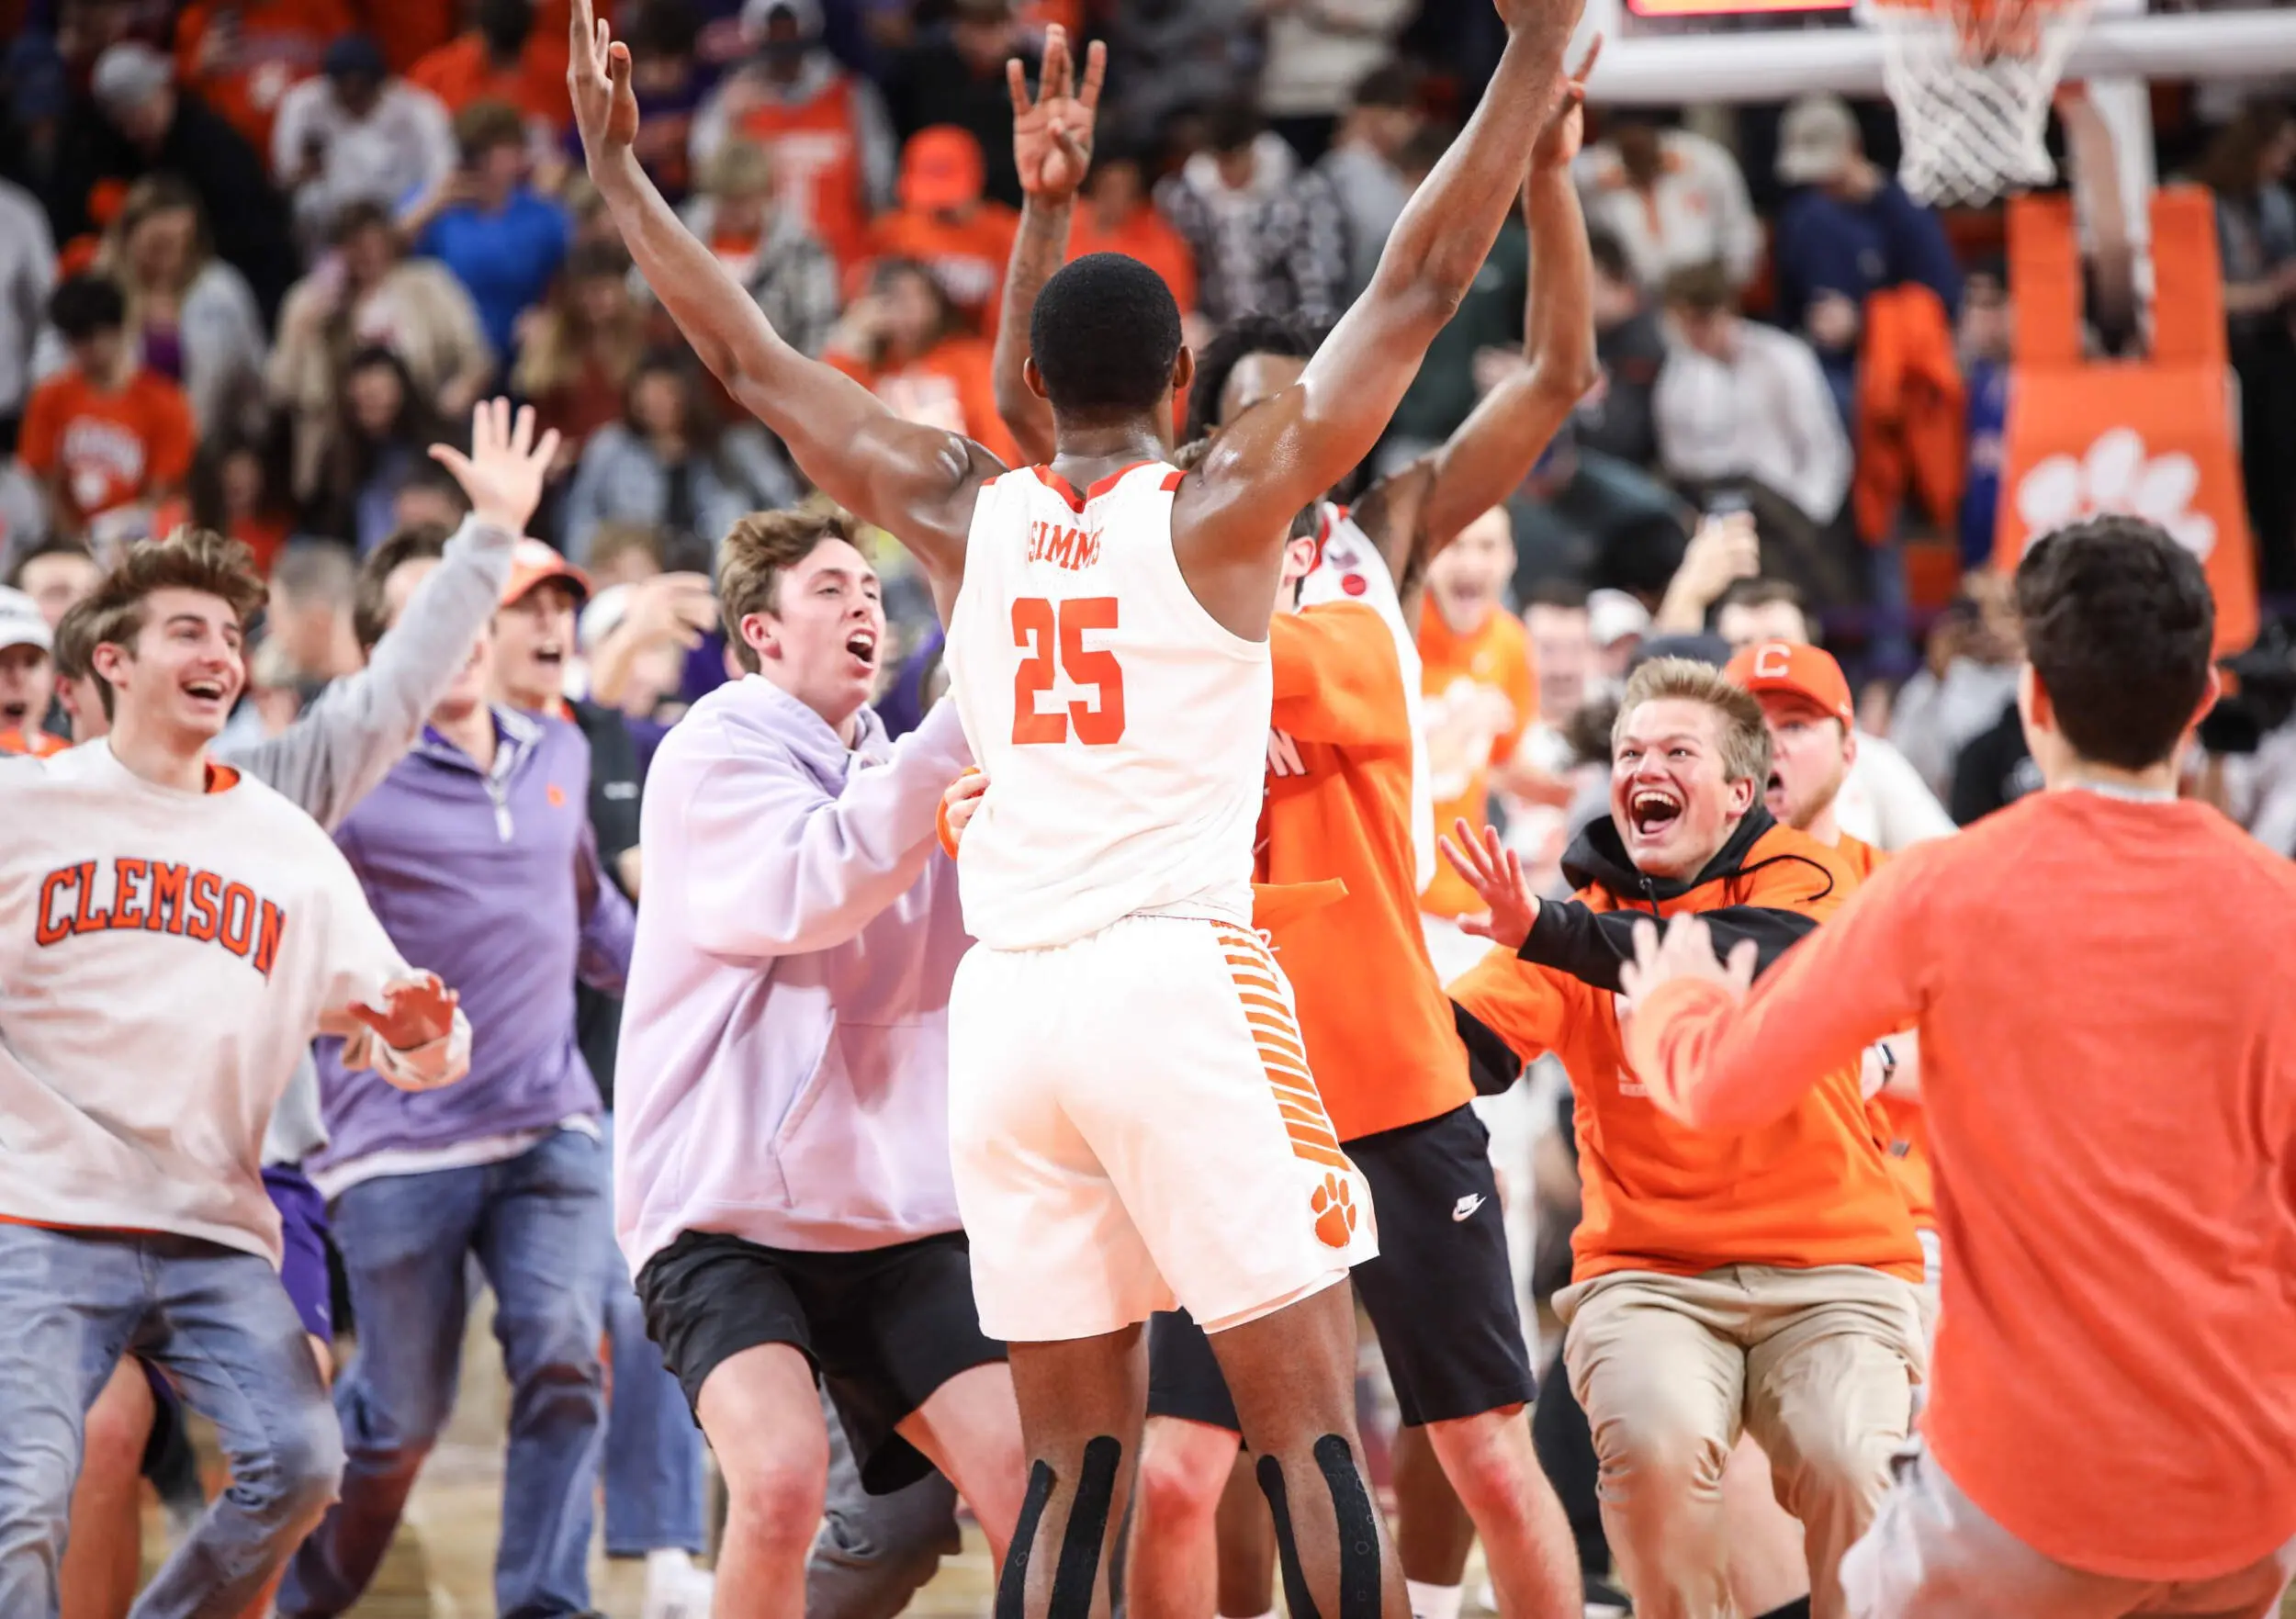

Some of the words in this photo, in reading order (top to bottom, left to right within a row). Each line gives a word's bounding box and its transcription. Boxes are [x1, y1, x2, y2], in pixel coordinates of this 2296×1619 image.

[1028, 520, 1104, 570] SIMMS
[1011, 596, 1126, 746] 25
[1755, 643, 1792, 678] C
[35, 856, 287, 979] CLEMSON
